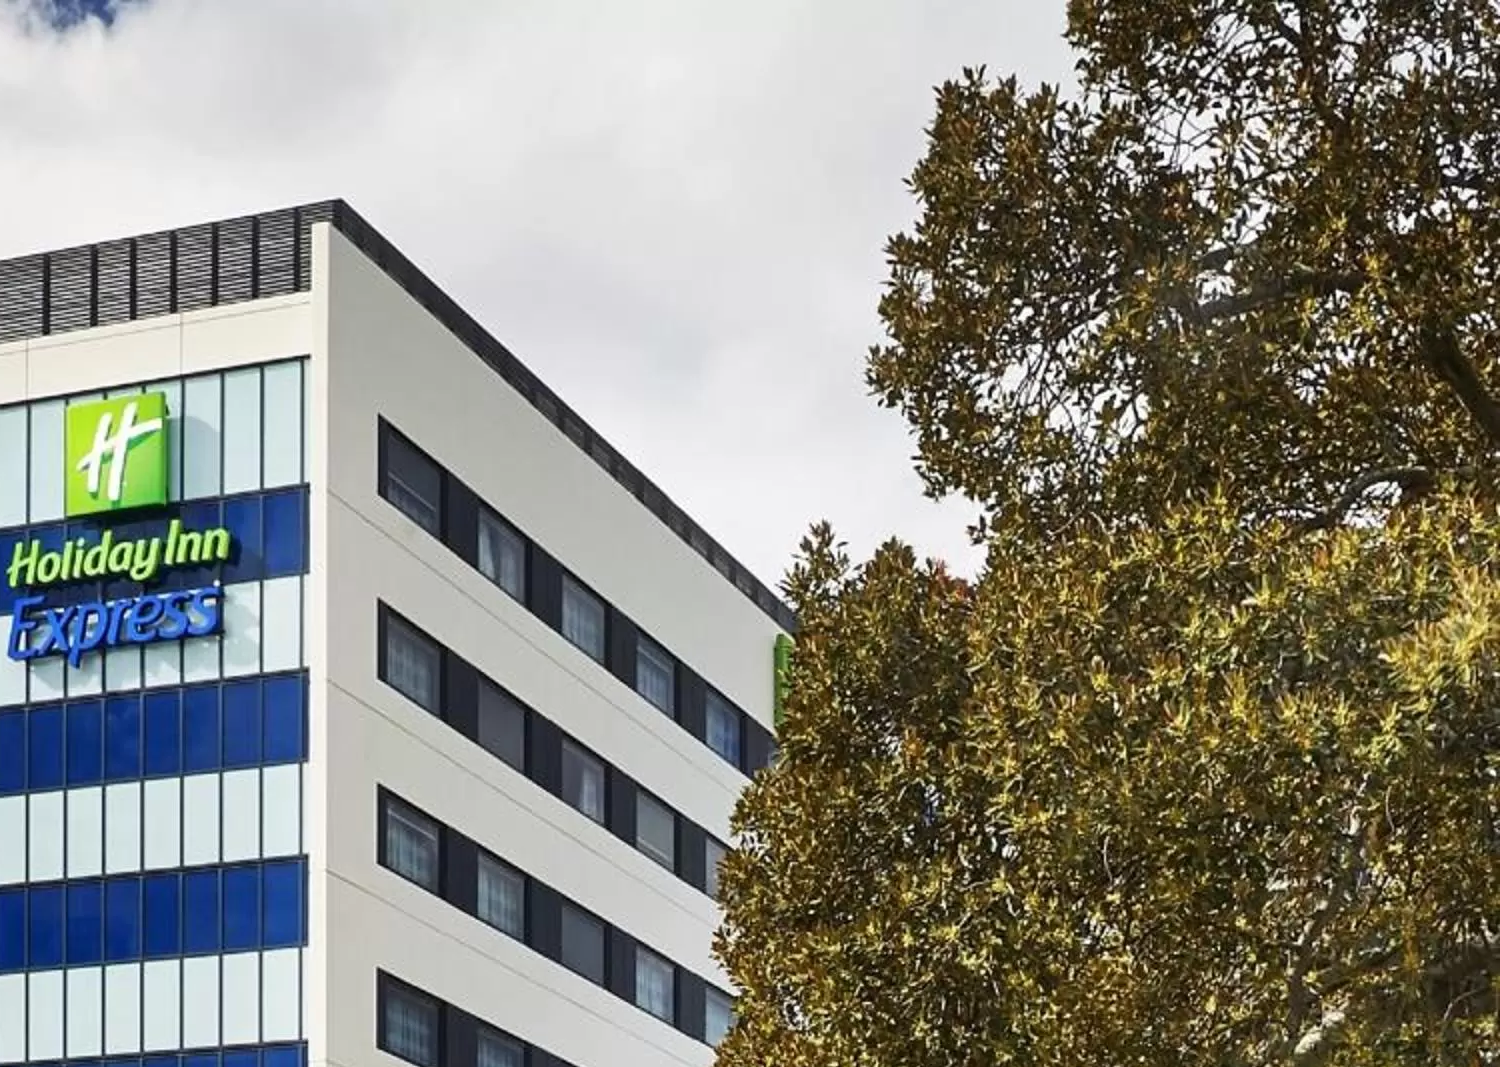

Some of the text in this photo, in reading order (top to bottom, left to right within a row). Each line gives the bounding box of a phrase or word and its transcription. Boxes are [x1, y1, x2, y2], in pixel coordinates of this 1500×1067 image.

[76, 402, 162, 501] H
[6, 519, 231, 588] Holiday Inn
[7, 585, 224, 669] Express
